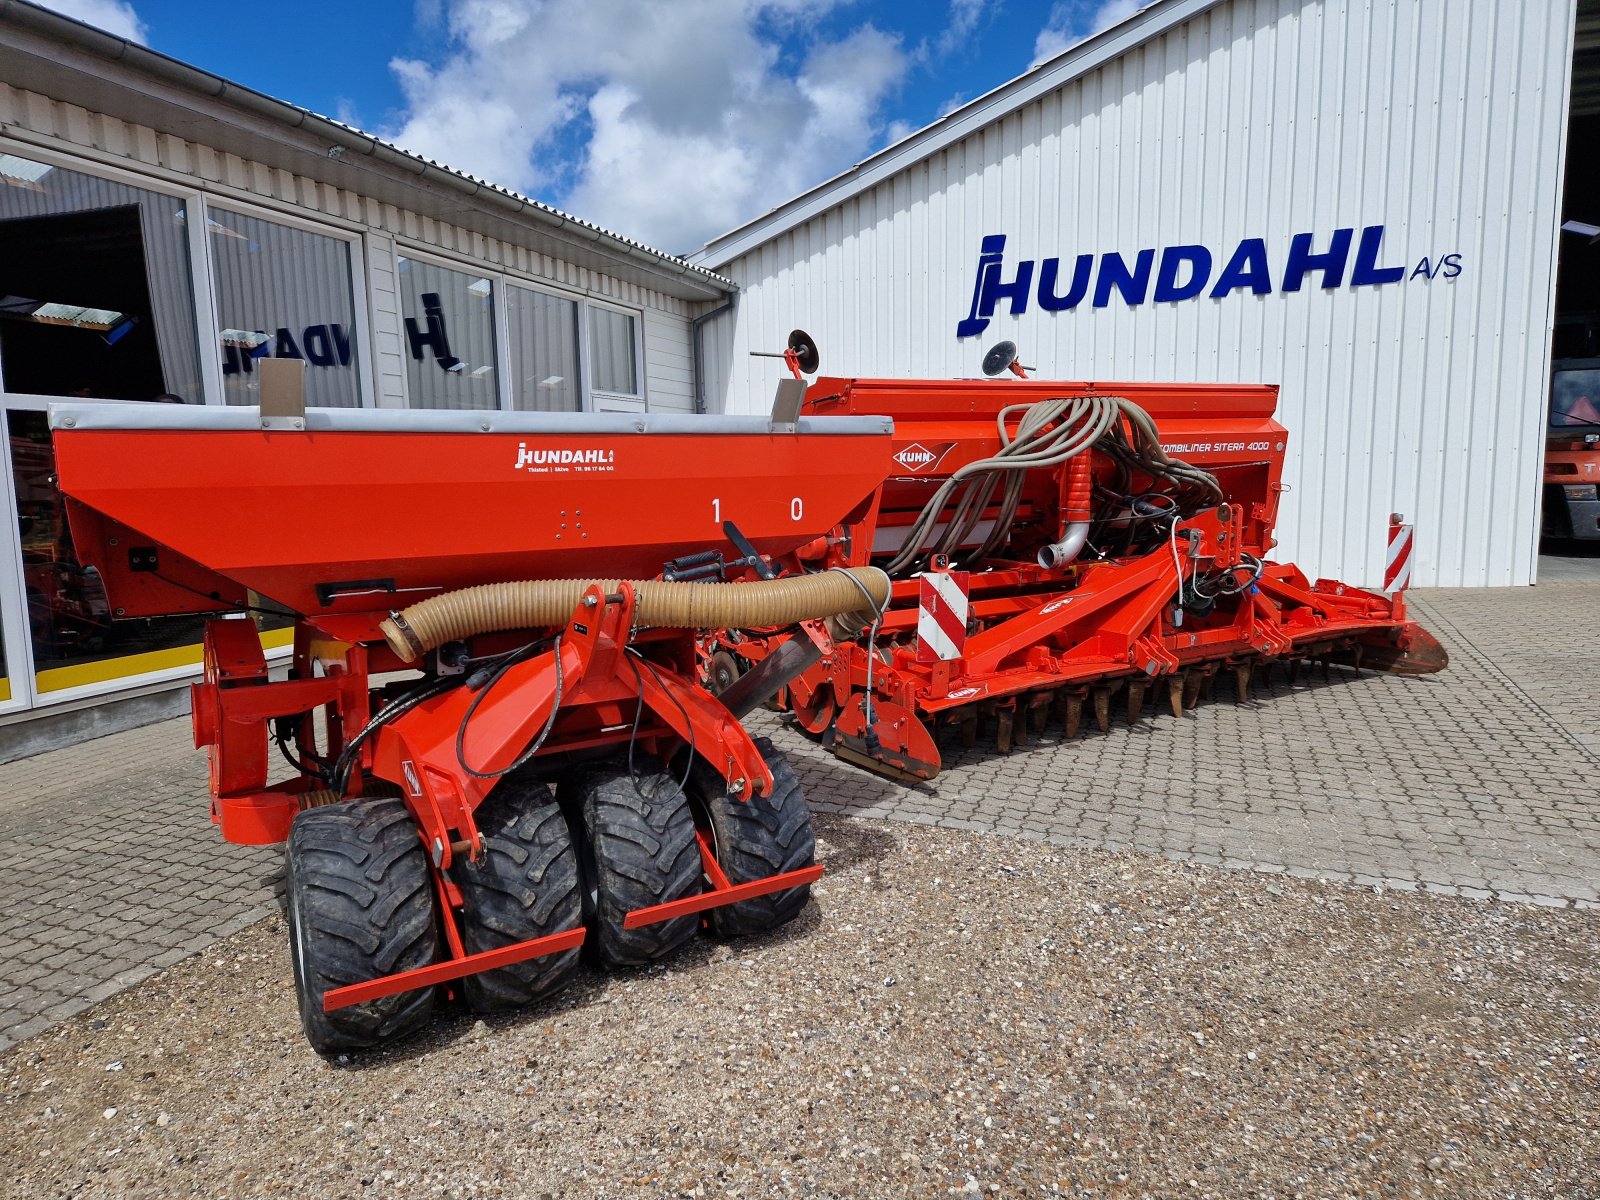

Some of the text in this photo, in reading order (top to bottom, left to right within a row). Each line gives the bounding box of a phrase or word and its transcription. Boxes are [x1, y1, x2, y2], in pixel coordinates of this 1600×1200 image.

[1409, 253, 1463, 281] A/S
[1213, 442, 1245, 452] SITERA
[1246, 441, 1270, 451] 4000
[899, 452, 930, 462] KUHN
[712, 497, 803, 523] 1 0
